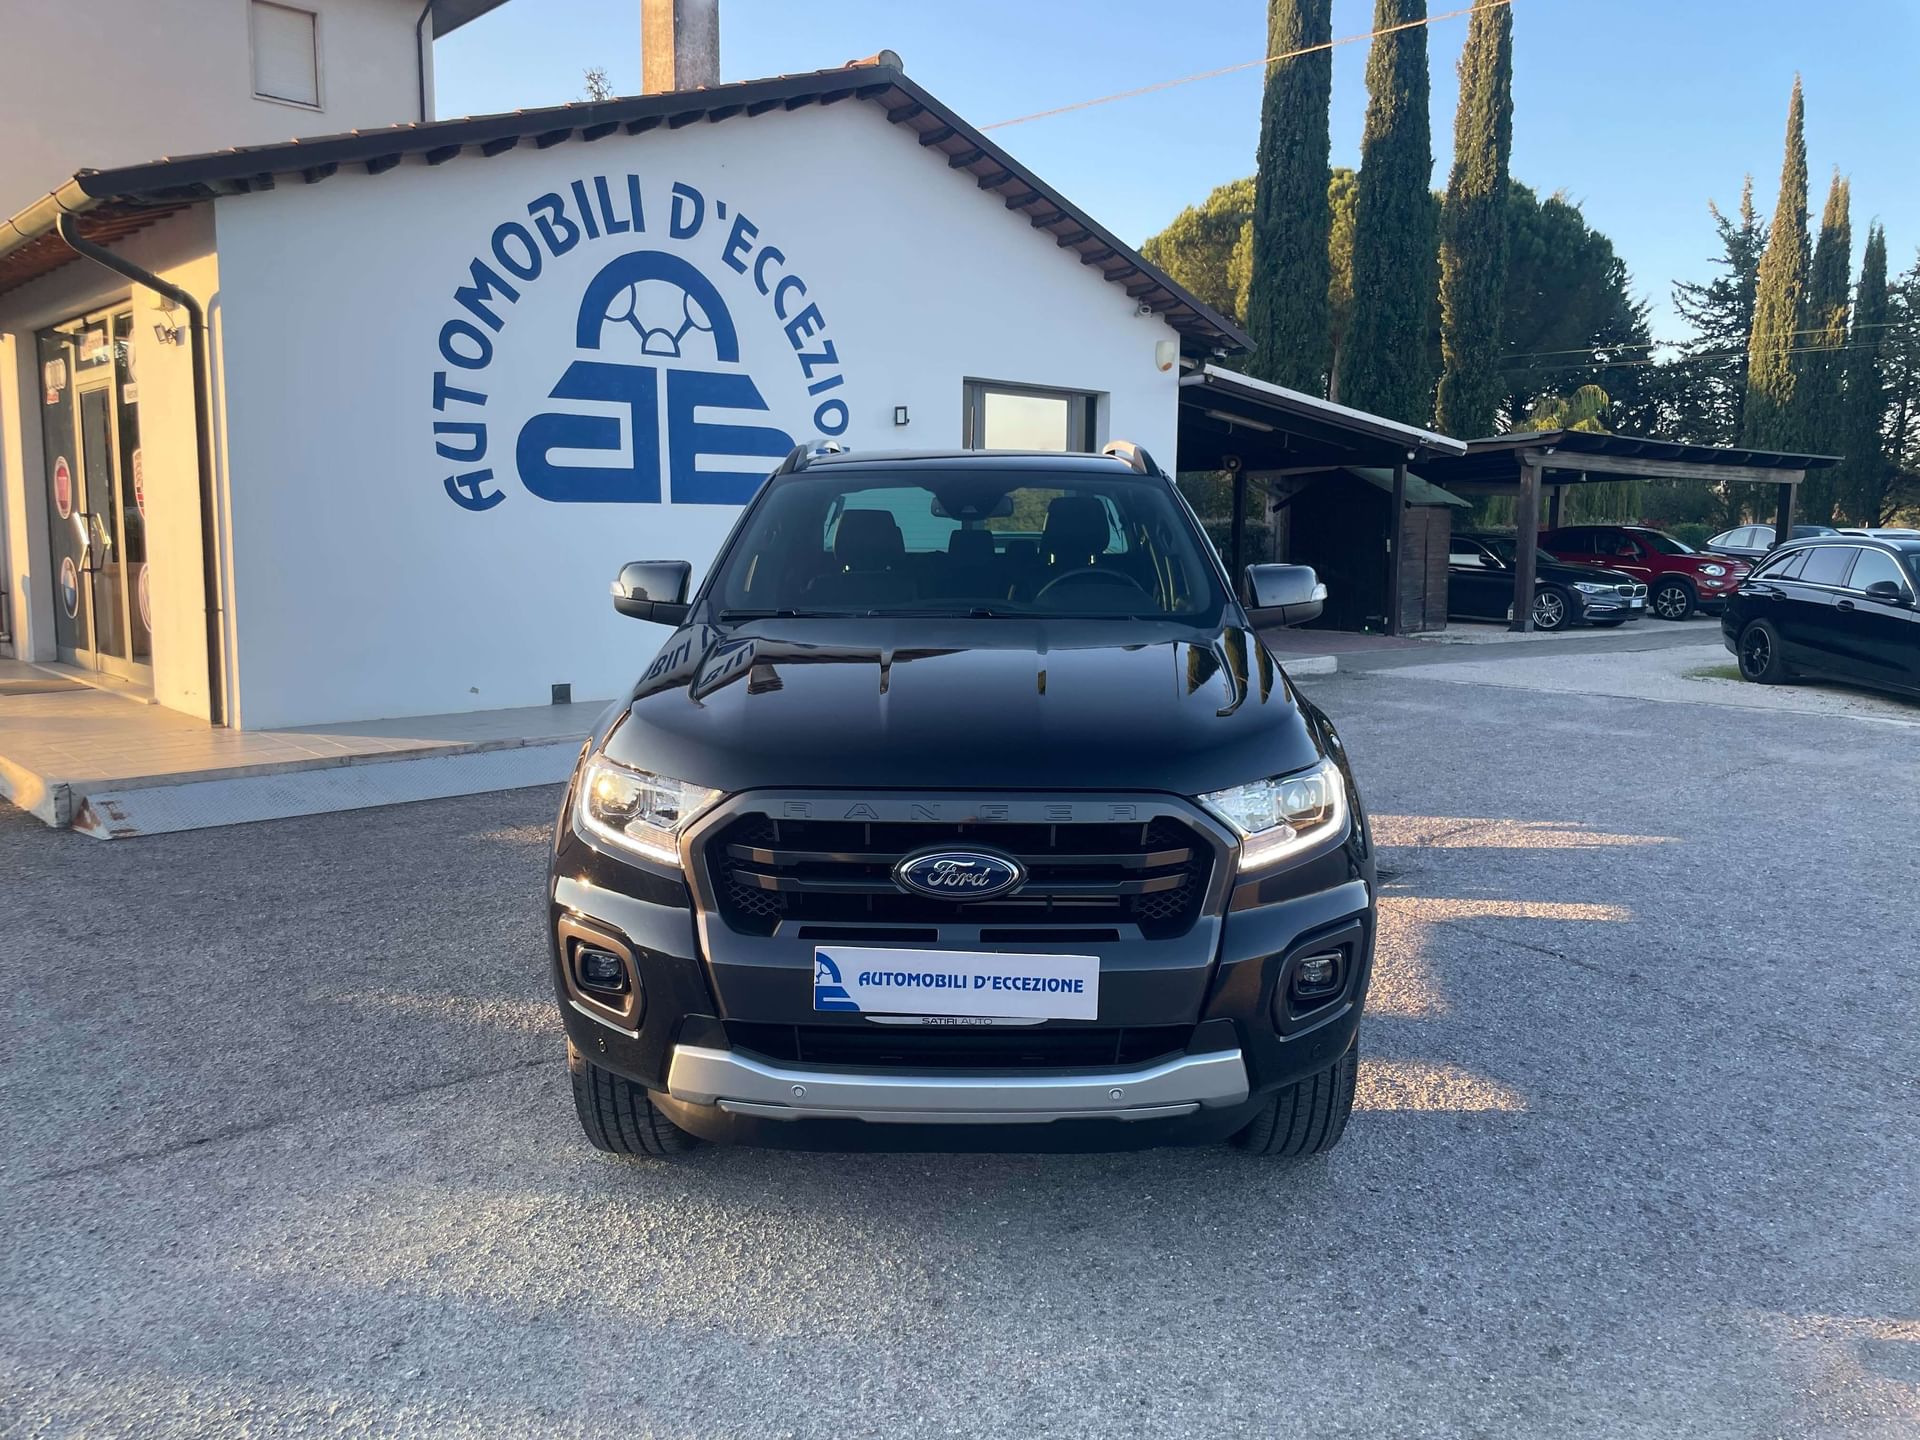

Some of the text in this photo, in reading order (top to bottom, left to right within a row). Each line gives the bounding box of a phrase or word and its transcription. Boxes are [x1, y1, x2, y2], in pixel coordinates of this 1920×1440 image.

[433, 174, 850, 512] AUTOMOBILI D'ECCEZIO
[783, 801, 1137, 822] RANGER
[927, 860, 991, 886] Ford
[858, 971, 1084, 993] AUTOMOBILI D'ECCEZIONE
